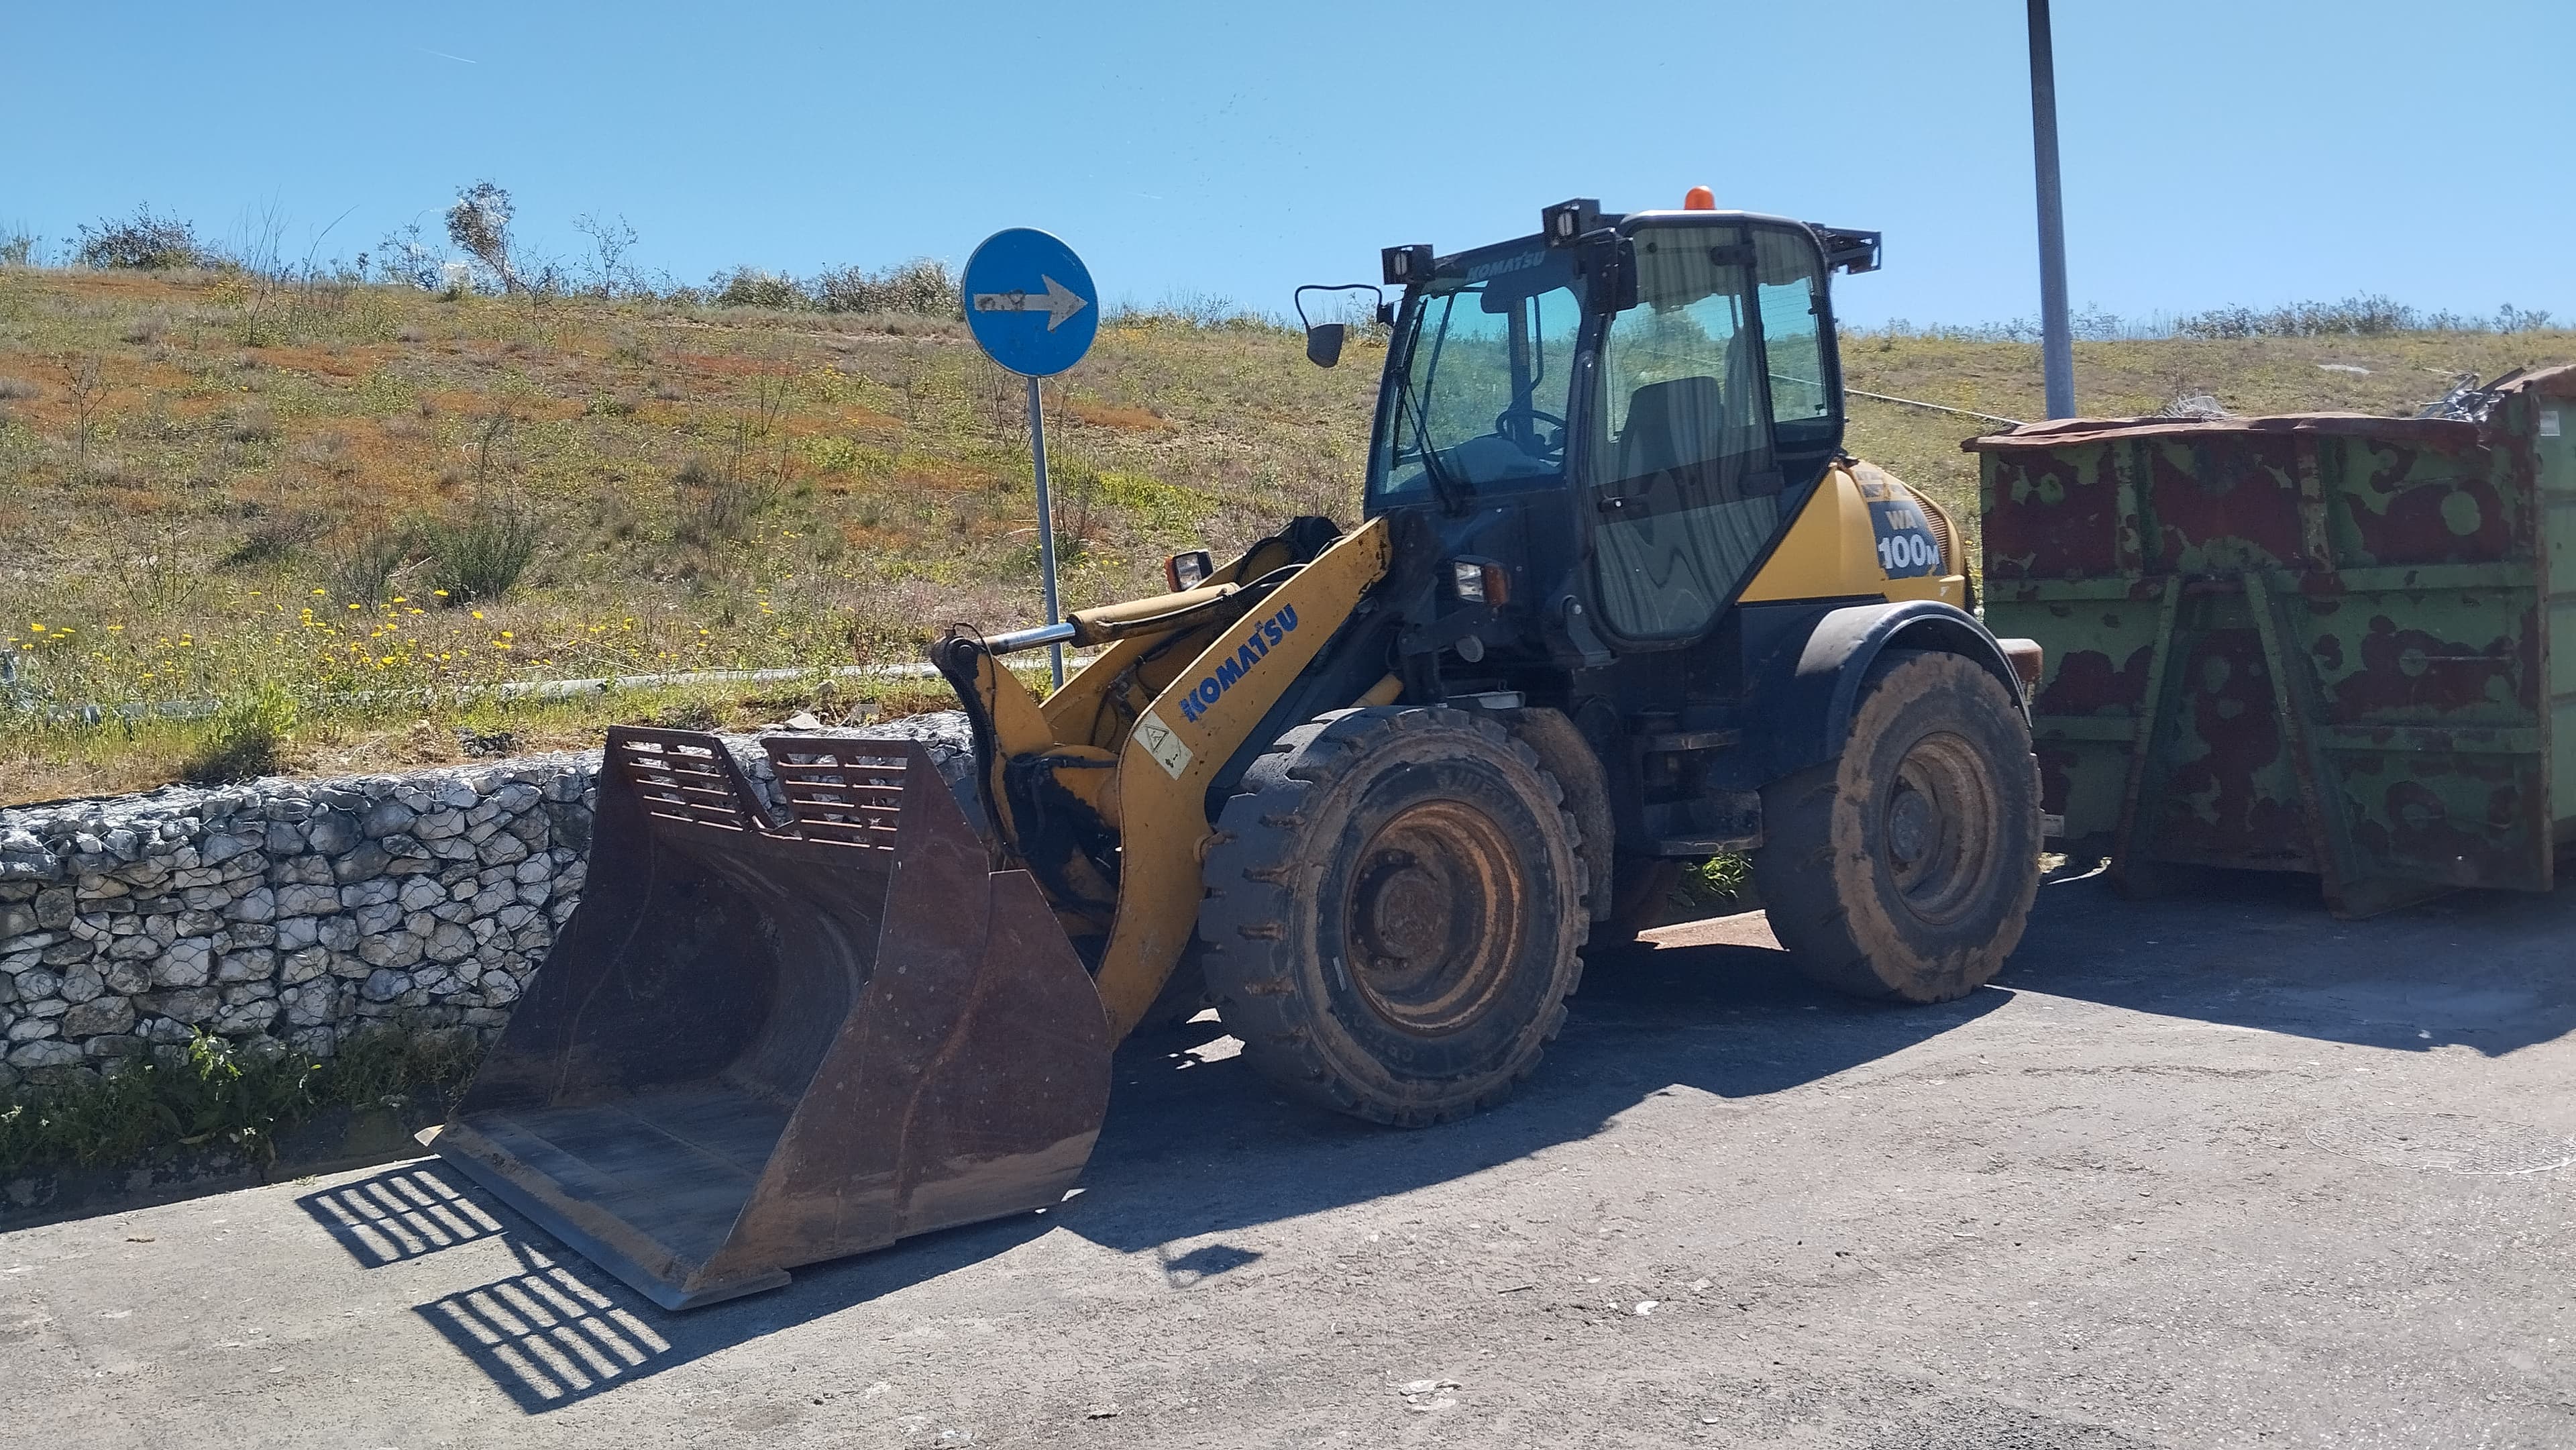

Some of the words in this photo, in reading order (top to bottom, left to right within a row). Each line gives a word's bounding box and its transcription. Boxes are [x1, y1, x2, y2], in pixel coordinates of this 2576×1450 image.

[1466, 250, 1546, 281] KOMATSU
[1885, 510, 1918, 530] WA
[1179, 603, 1298, 723] KOMATSU
